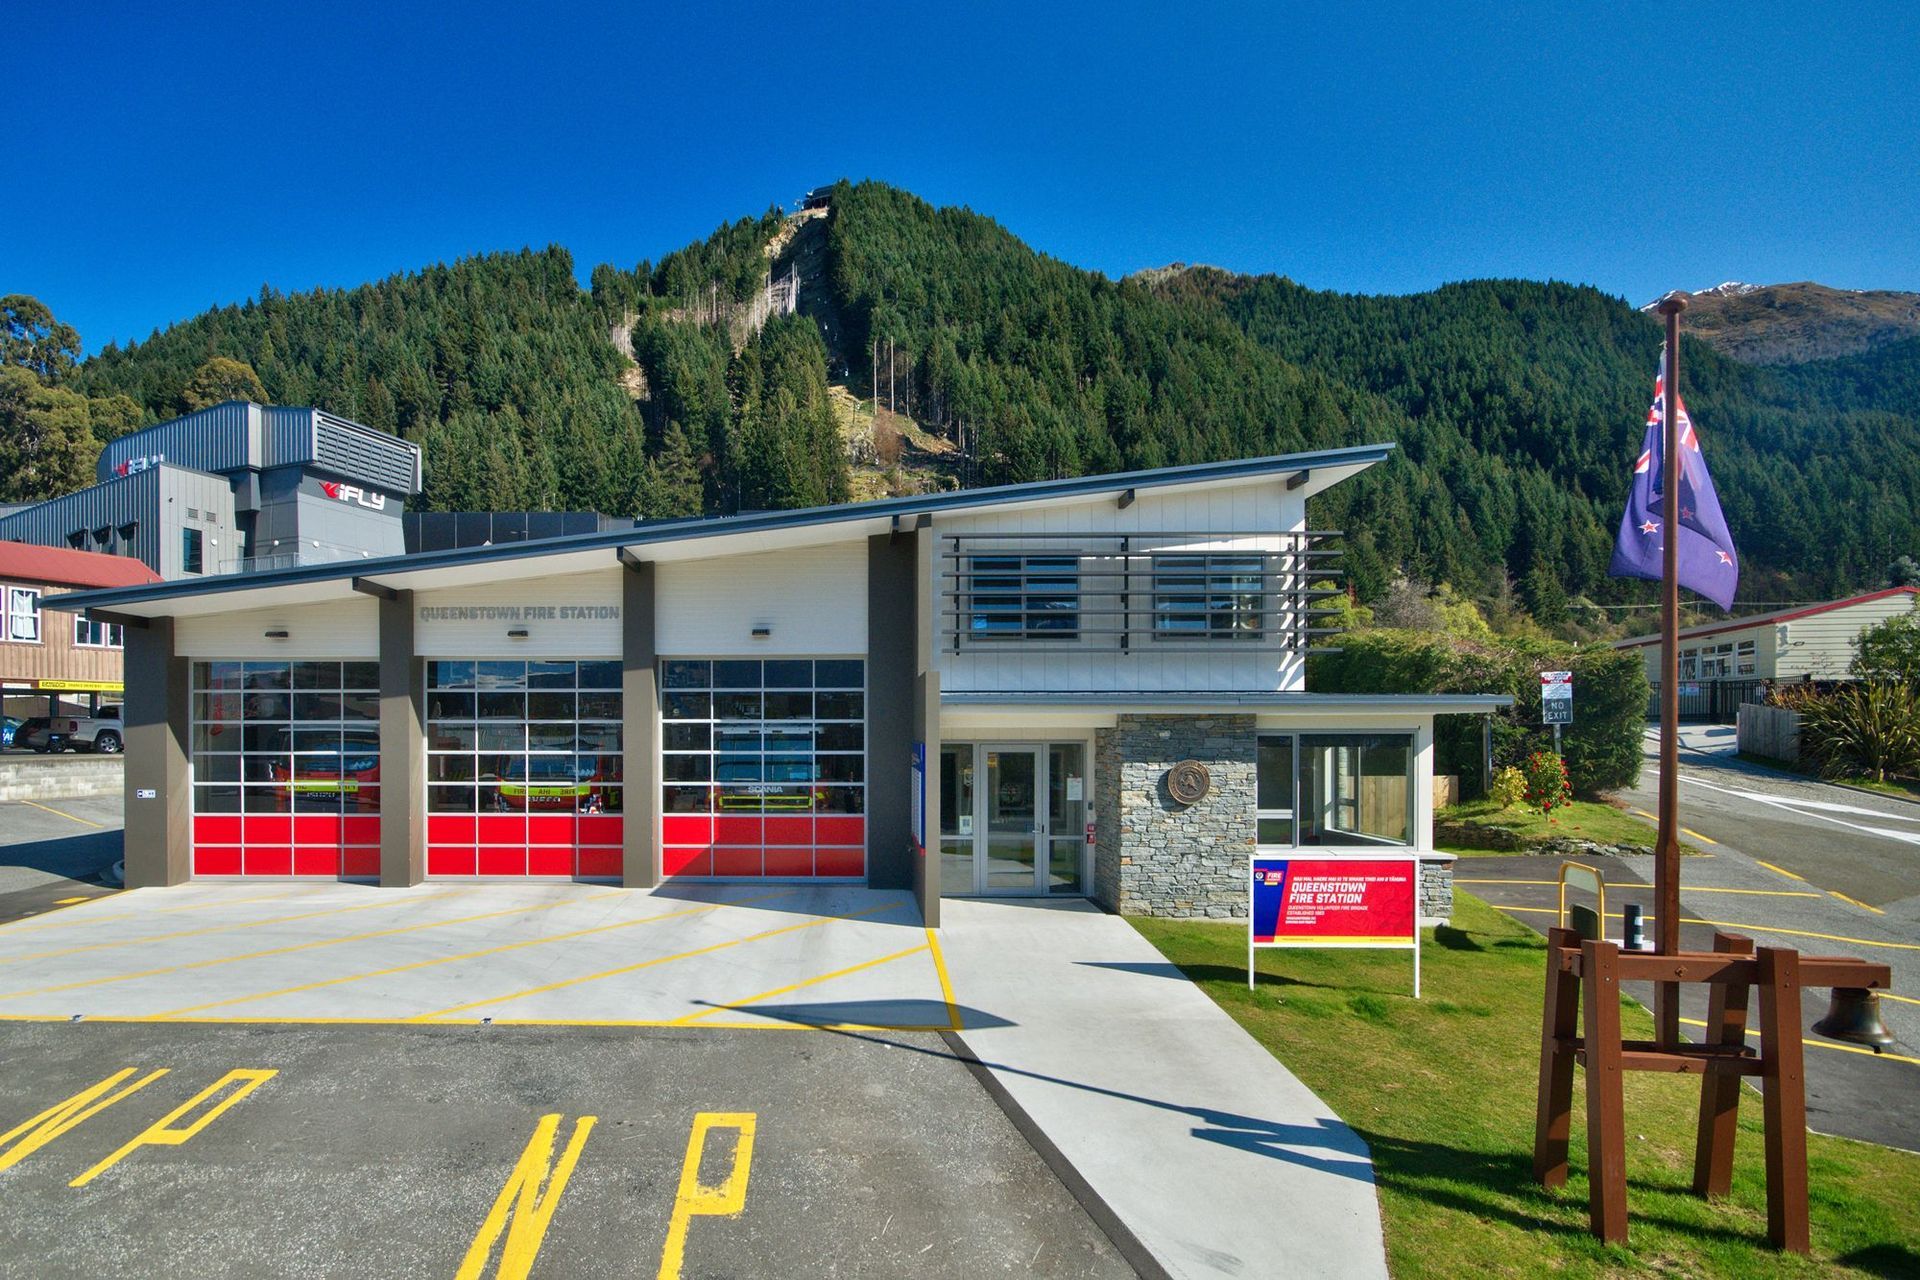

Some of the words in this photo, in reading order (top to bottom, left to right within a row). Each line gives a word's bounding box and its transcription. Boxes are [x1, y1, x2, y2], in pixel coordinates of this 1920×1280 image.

[420, 606, 520, 621] QUEENSTOWN
[524, 606, 556, 619] FIRE
[559, 606, 620, 620] STATION
[1548, 711, 1567, 719] EXIT
[1291, 882, 1367, 893] QUEENSTOWN
[1289, 893, 1314, 903] FIRE
[1316, 893, 1362, 904] STATION
